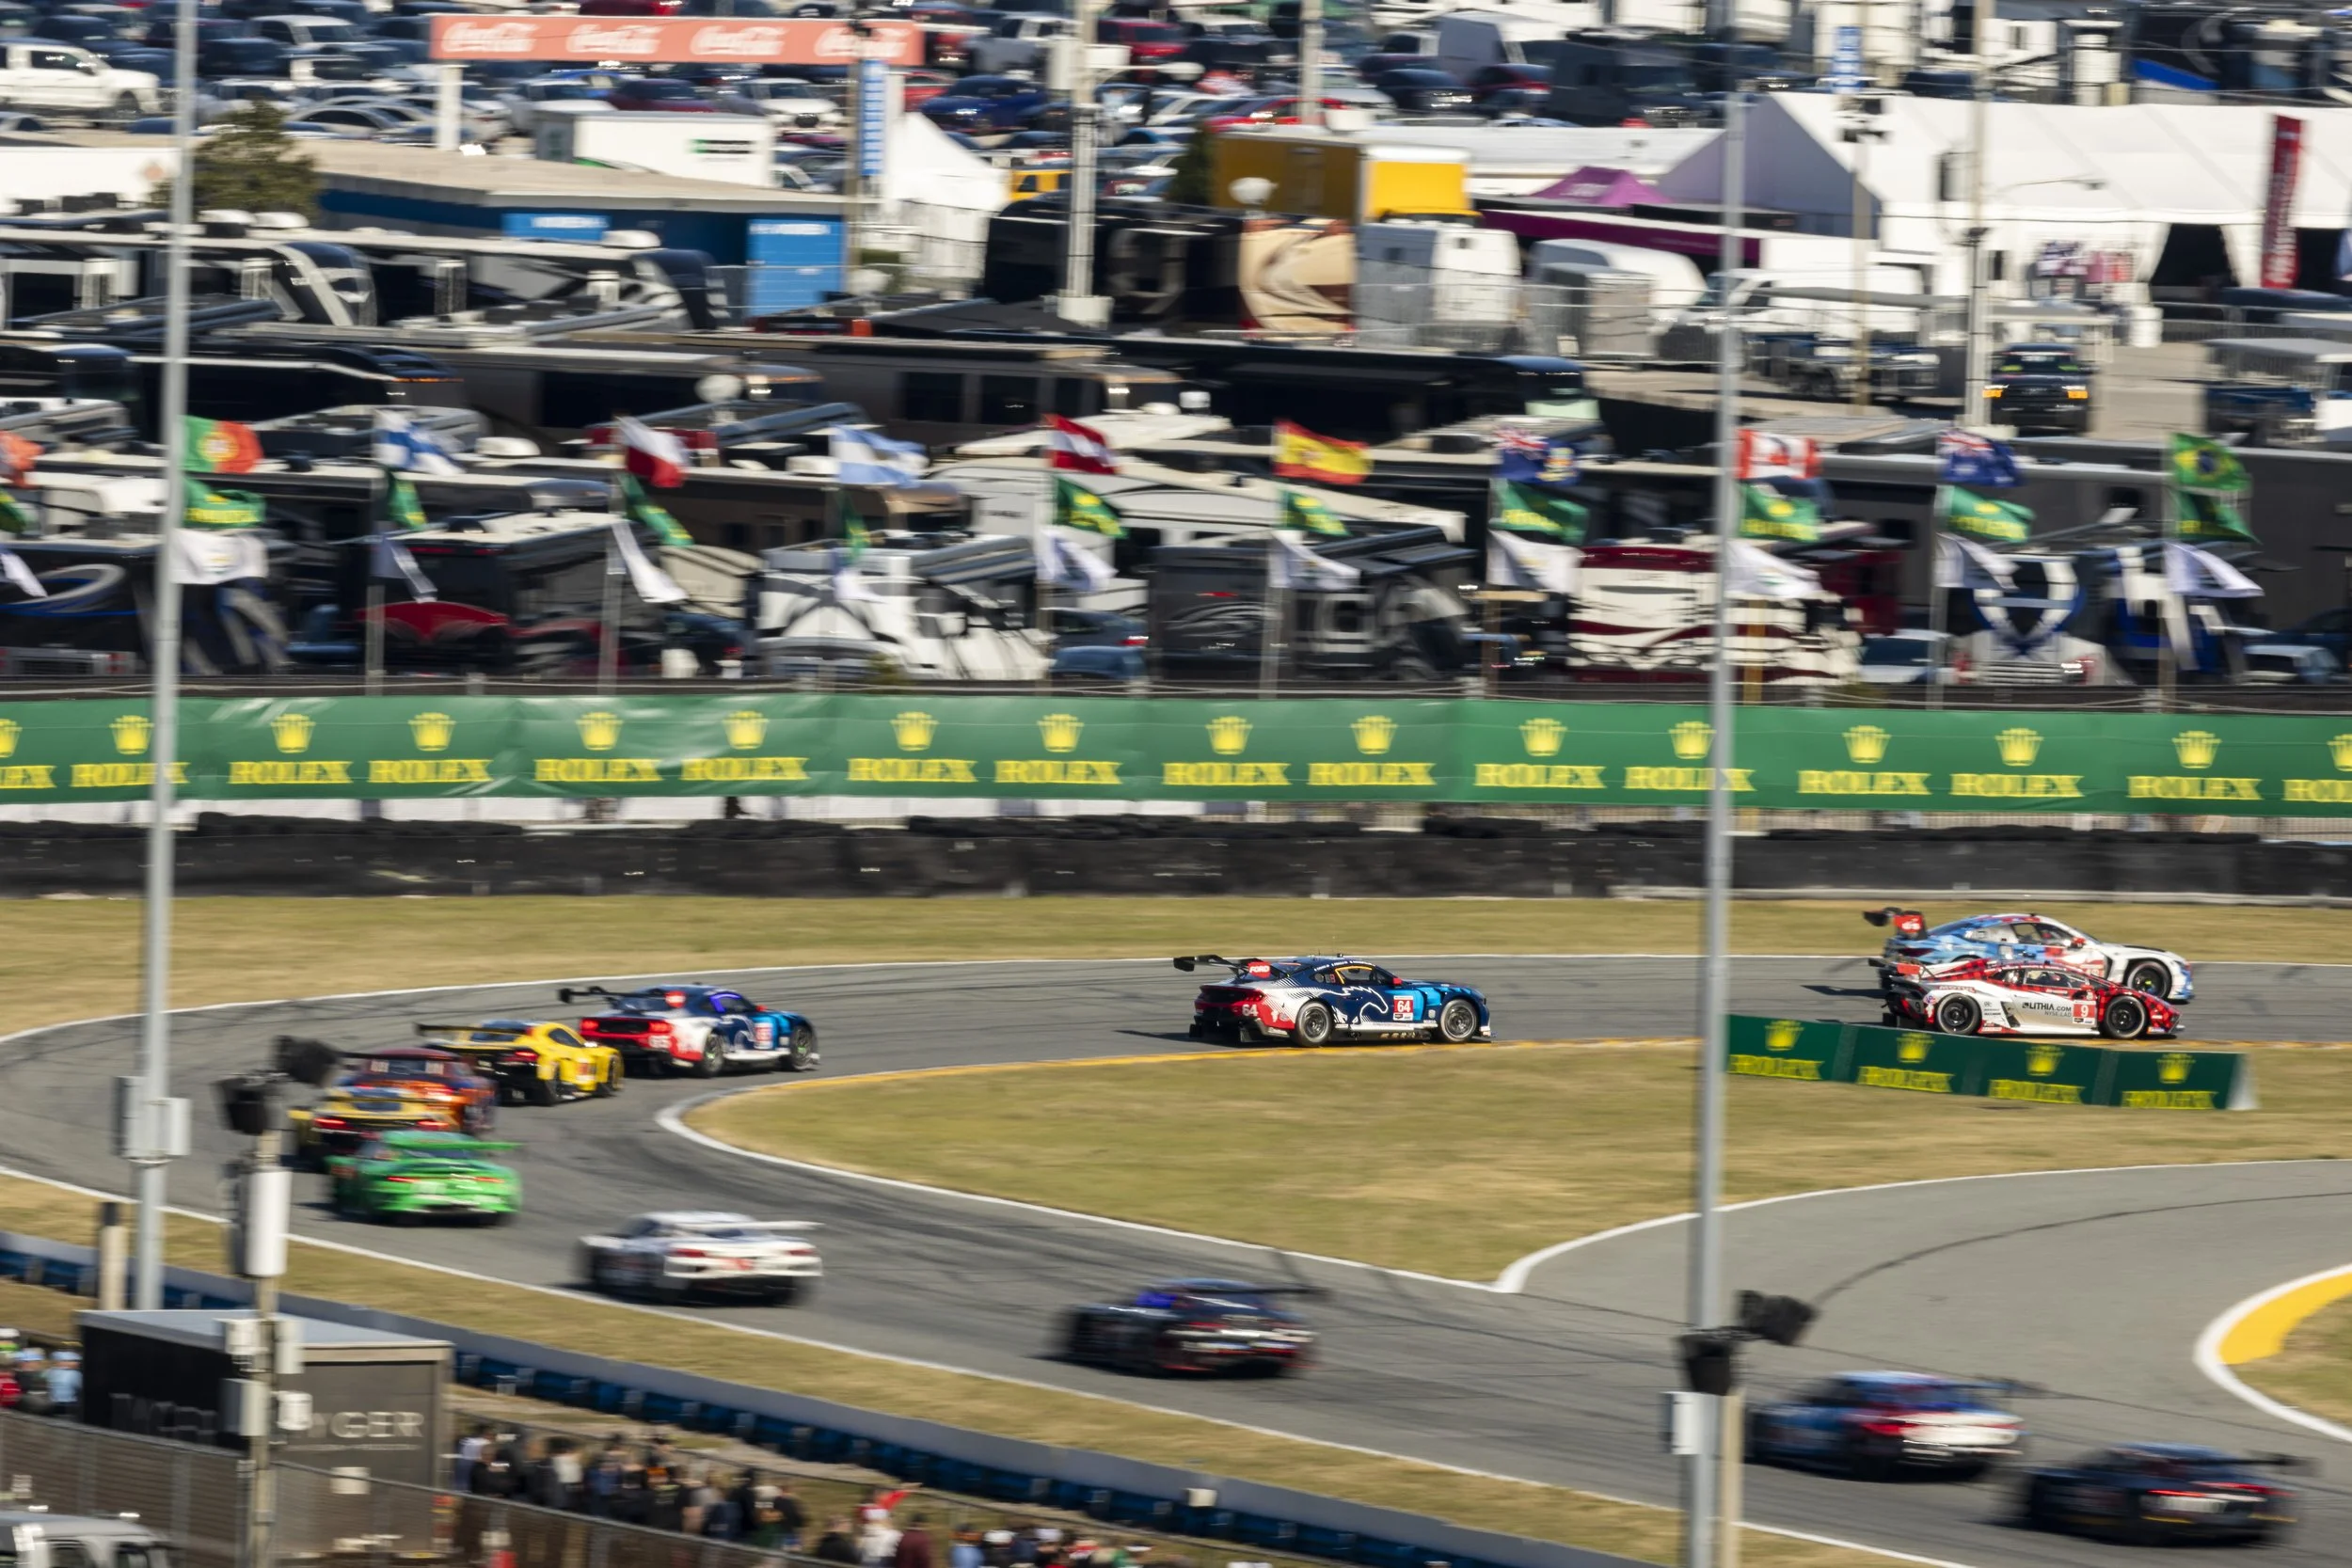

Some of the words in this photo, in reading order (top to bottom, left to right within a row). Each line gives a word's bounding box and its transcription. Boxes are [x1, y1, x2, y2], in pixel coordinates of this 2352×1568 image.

[229, 761, 352, 784] ROLEX
[369, 759, 492, 783] ROLEX
[534, 758, 662, 782] ROLEX
[680, 757, 809, 781] ROLEX
[847, 758, 977, 783] ROLEX
[994, 760, 1121, 784] ROLEX
[1162, 762, 1291, 786] ROLEX
[1308, 762, 1436, 786] ROLEX
[1474, 764, 1605, 788] ROLEX
[1624, 767, 1757, 791] ROLEX
[1798, 770, 1931, 796] ROLEX
[1950, 773, 2084, 798] ROLEX
[2127, 776, 2264, 800] ROLEX
[1242, 1004, 1258, 1017] 64
[1397, 1000, 1411, 1013] 64
[2080, 1005, 2089, 1018] 9
